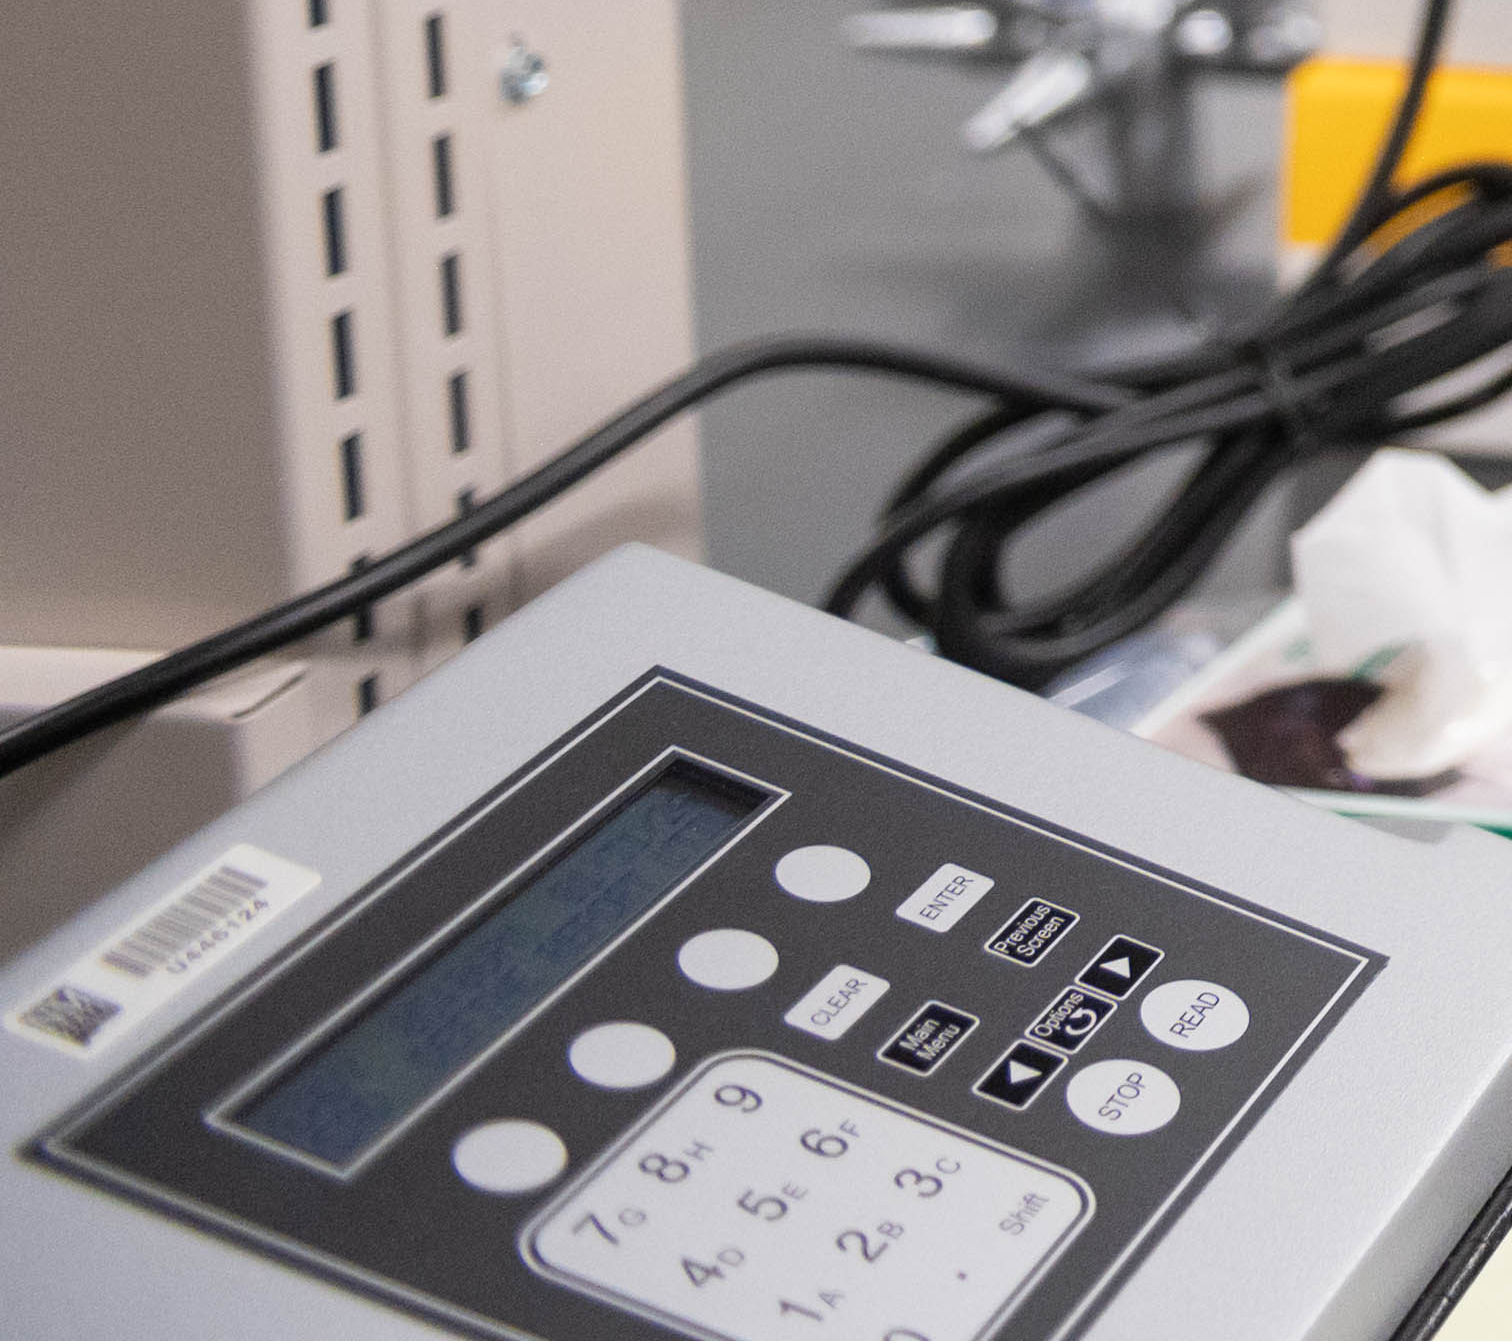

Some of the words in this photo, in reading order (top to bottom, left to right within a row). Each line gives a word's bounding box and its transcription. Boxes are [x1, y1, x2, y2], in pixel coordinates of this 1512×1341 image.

[919, 874, 975, 921] ENTER
[993, 903, 1051, 955] Previous
[1016, 915, 1065, 957] Screen
[810, 977, 869, 1026] CLEAR
[1033, 991, 1084, 1038] Options
[1169, 991, 1221, 1038] READ
[899, 1018, 939, 1052] Main
[916, 1024, 961, 1062] Menu
[713, 1083, 762, 1113] 9
[1097, 1071, 1147, 1121] STOP
[800, 1128, 849, 1158] 6
[638, 1153, 690, 1184] 8
[893, 1169, 943, 1199] 3
[737, 1189, 788, 1222] 5
[999, 1192, 1050, 1236] Shift
[572, 1213, 620, 1247] 7
[836, 1229, 888, 1263] 2
[681, 1257, 725, 1288] 4
[779, 1299, 824, 1322] 1
